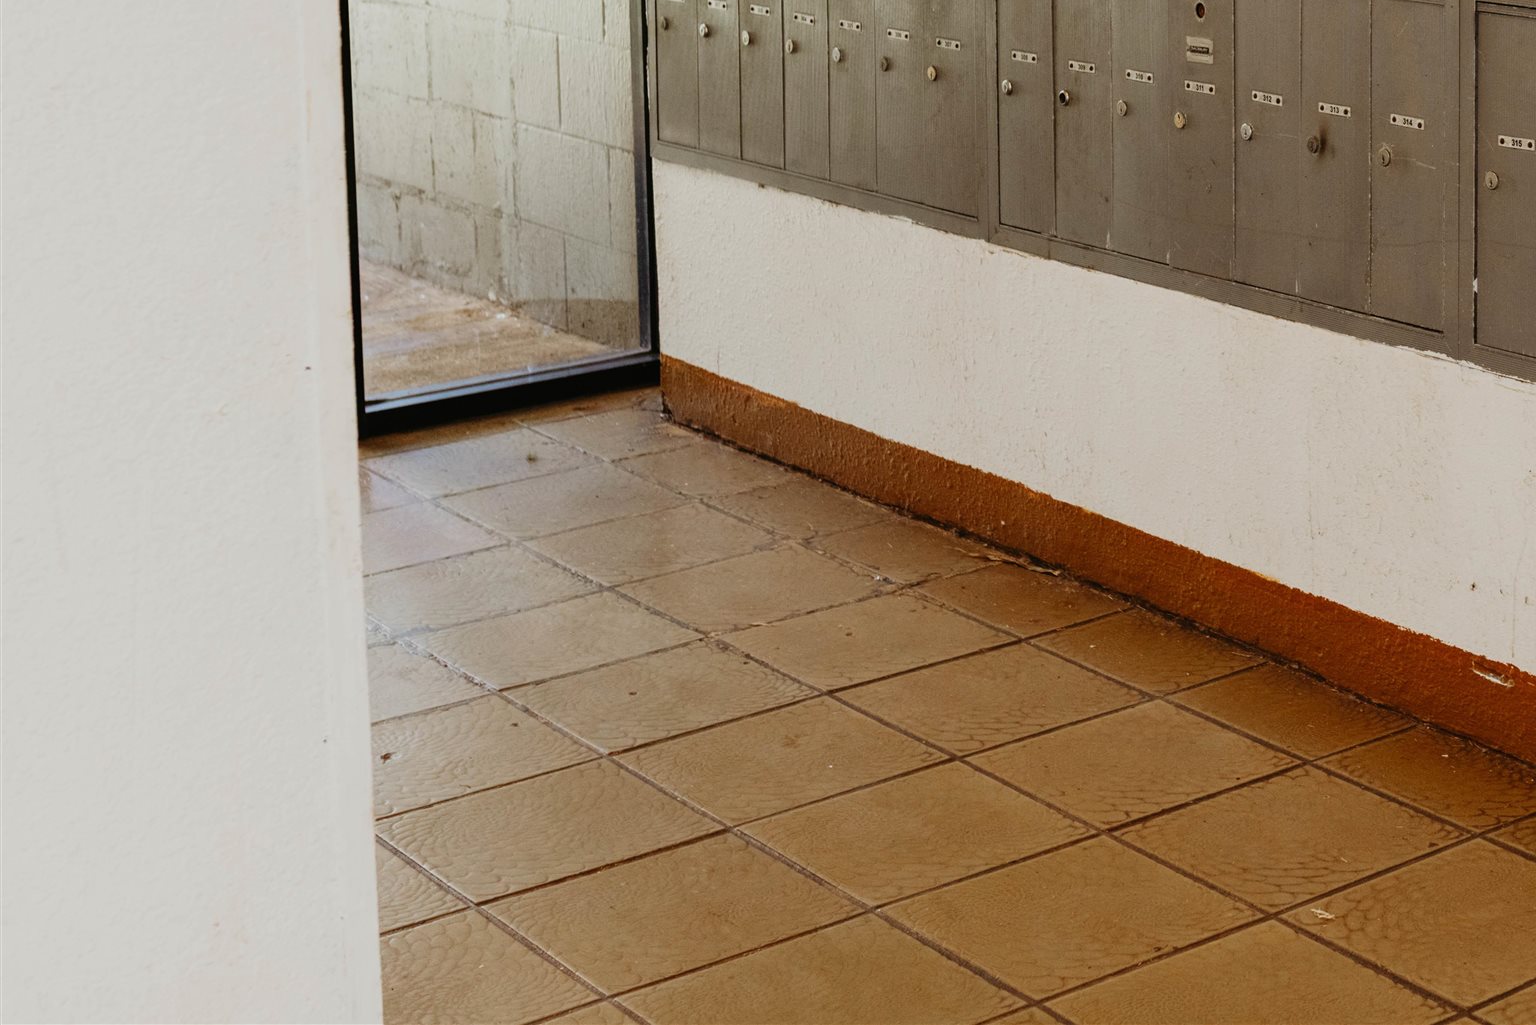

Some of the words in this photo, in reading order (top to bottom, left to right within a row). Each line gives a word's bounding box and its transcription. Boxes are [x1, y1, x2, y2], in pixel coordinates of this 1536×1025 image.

[1262, 94, 1272, 103] 312
[1330, 105, 1339, 113] 313
[1402, 118, 1413, 126] 314
[1511, 139, 1522, 147] 315
